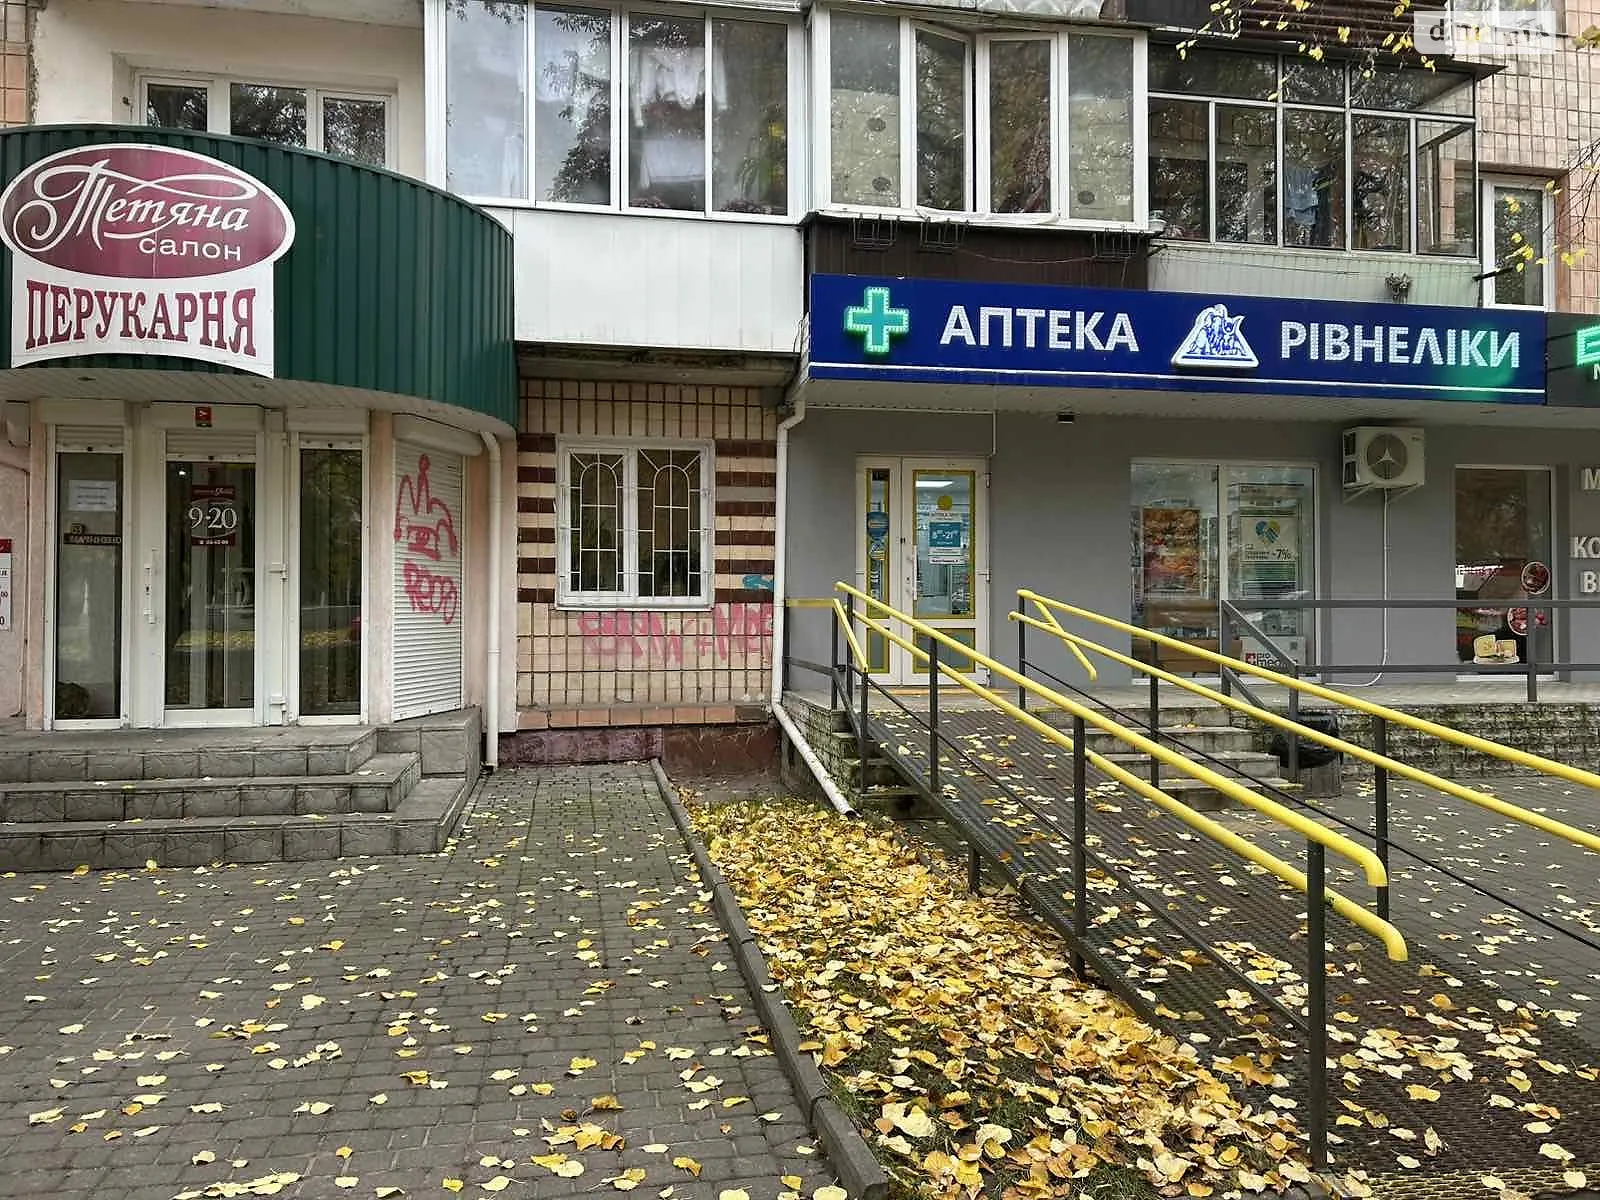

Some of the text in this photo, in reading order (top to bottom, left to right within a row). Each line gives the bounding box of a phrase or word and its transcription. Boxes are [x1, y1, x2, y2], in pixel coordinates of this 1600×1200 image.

[13, 159, 258, 252] Тетяна
[139, 238, 242, 261] салон
[25, 279, 257, 357] ПЕРУКАРНЯ
[940, 305, 1521, 369] АПТЕКА РІВНЕЛІКИ
